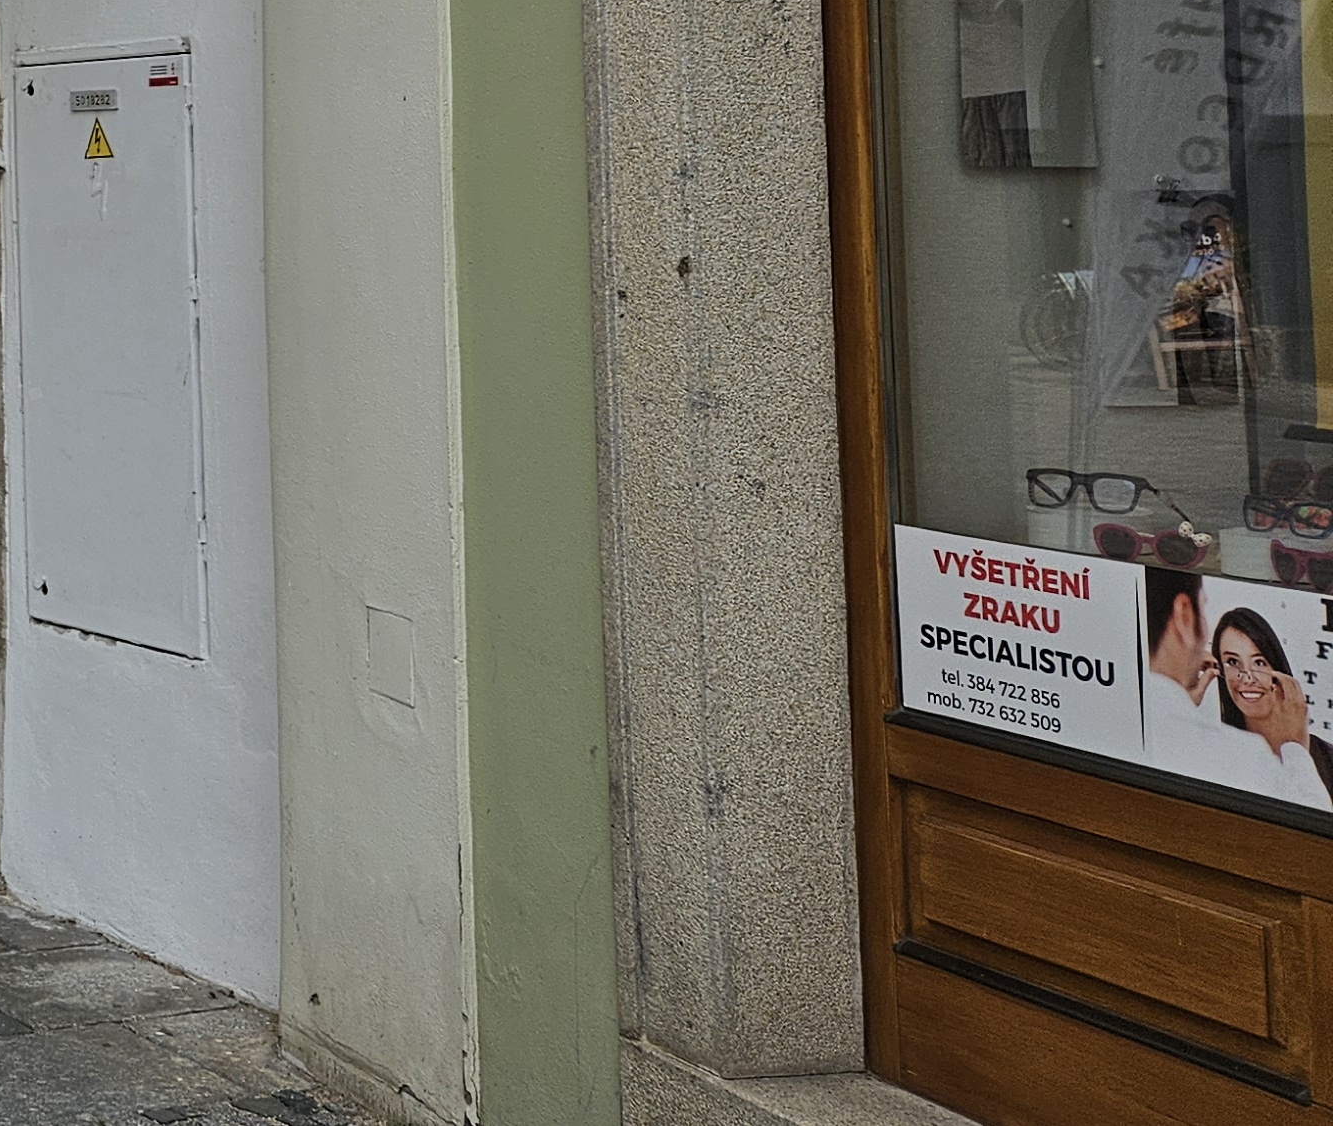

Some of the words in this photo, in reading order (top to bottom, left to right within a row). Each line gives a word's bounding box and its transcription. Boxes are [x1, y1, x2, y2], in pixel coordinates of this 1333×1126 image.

[933, 548, 1091, 600] VYŠETŘENÍ
[963, 591, 1061, 634] ZRAKU
[919, 623, 1115, 687] SPECIALISTOU
[941, 668, 965, 687] tel.
[966, 673, 995, 694] 384
[998, 680, 1027, 702] 722
[1030, 688, 1061, 709] 856
[926, 690, 966, 711] mob.
[968, 697, 996, 718] 732
[999, 705, 1027, 726] 632
[1030, 712, 1062, 734] 509
